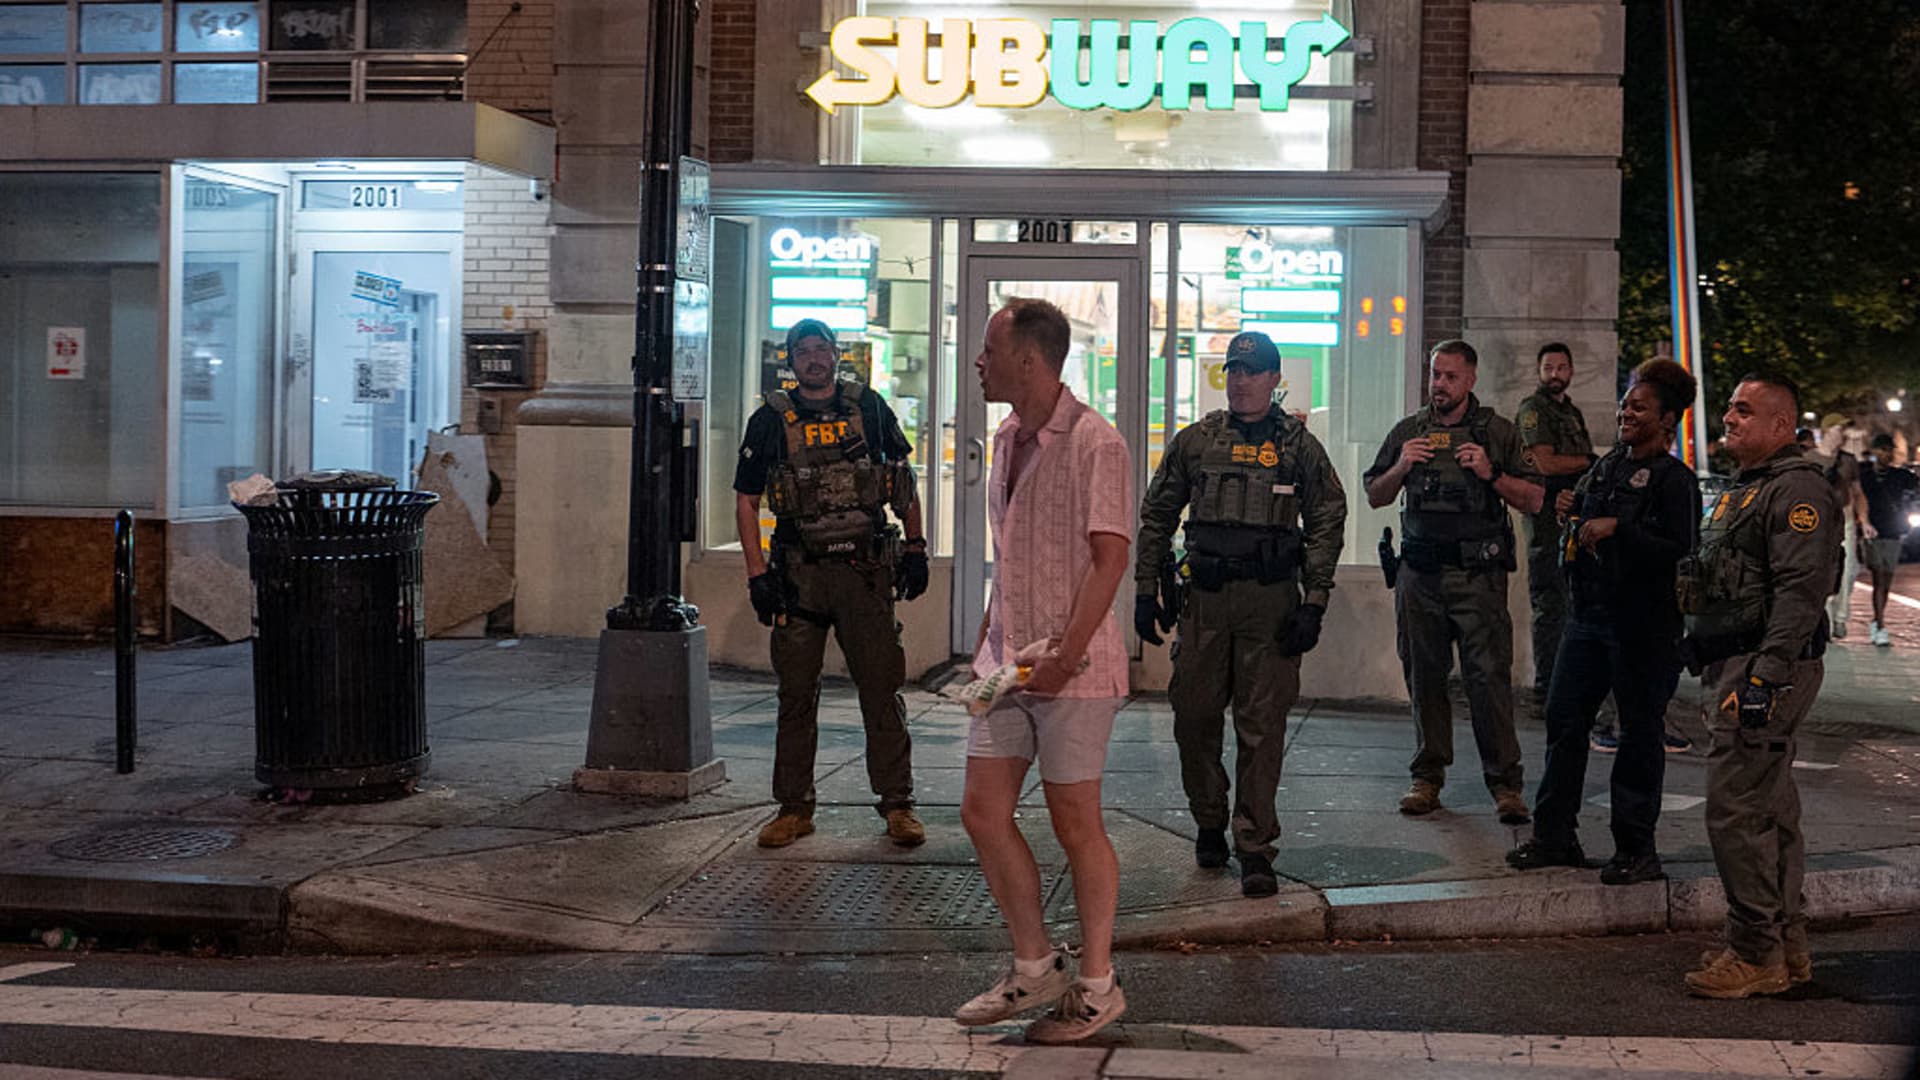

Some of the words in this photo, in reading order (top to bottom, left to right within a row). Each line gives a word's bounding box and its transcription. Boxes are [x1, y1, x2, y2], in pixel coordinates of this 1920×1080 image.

[805, 12, 1351, 115] SUBWAY
[352, 187, 399, 207] 2001
[769, 227, 871, 268] Open
[1018, 220, 1072, 243] 2001
[1239, 236, 1343, 283] Open
